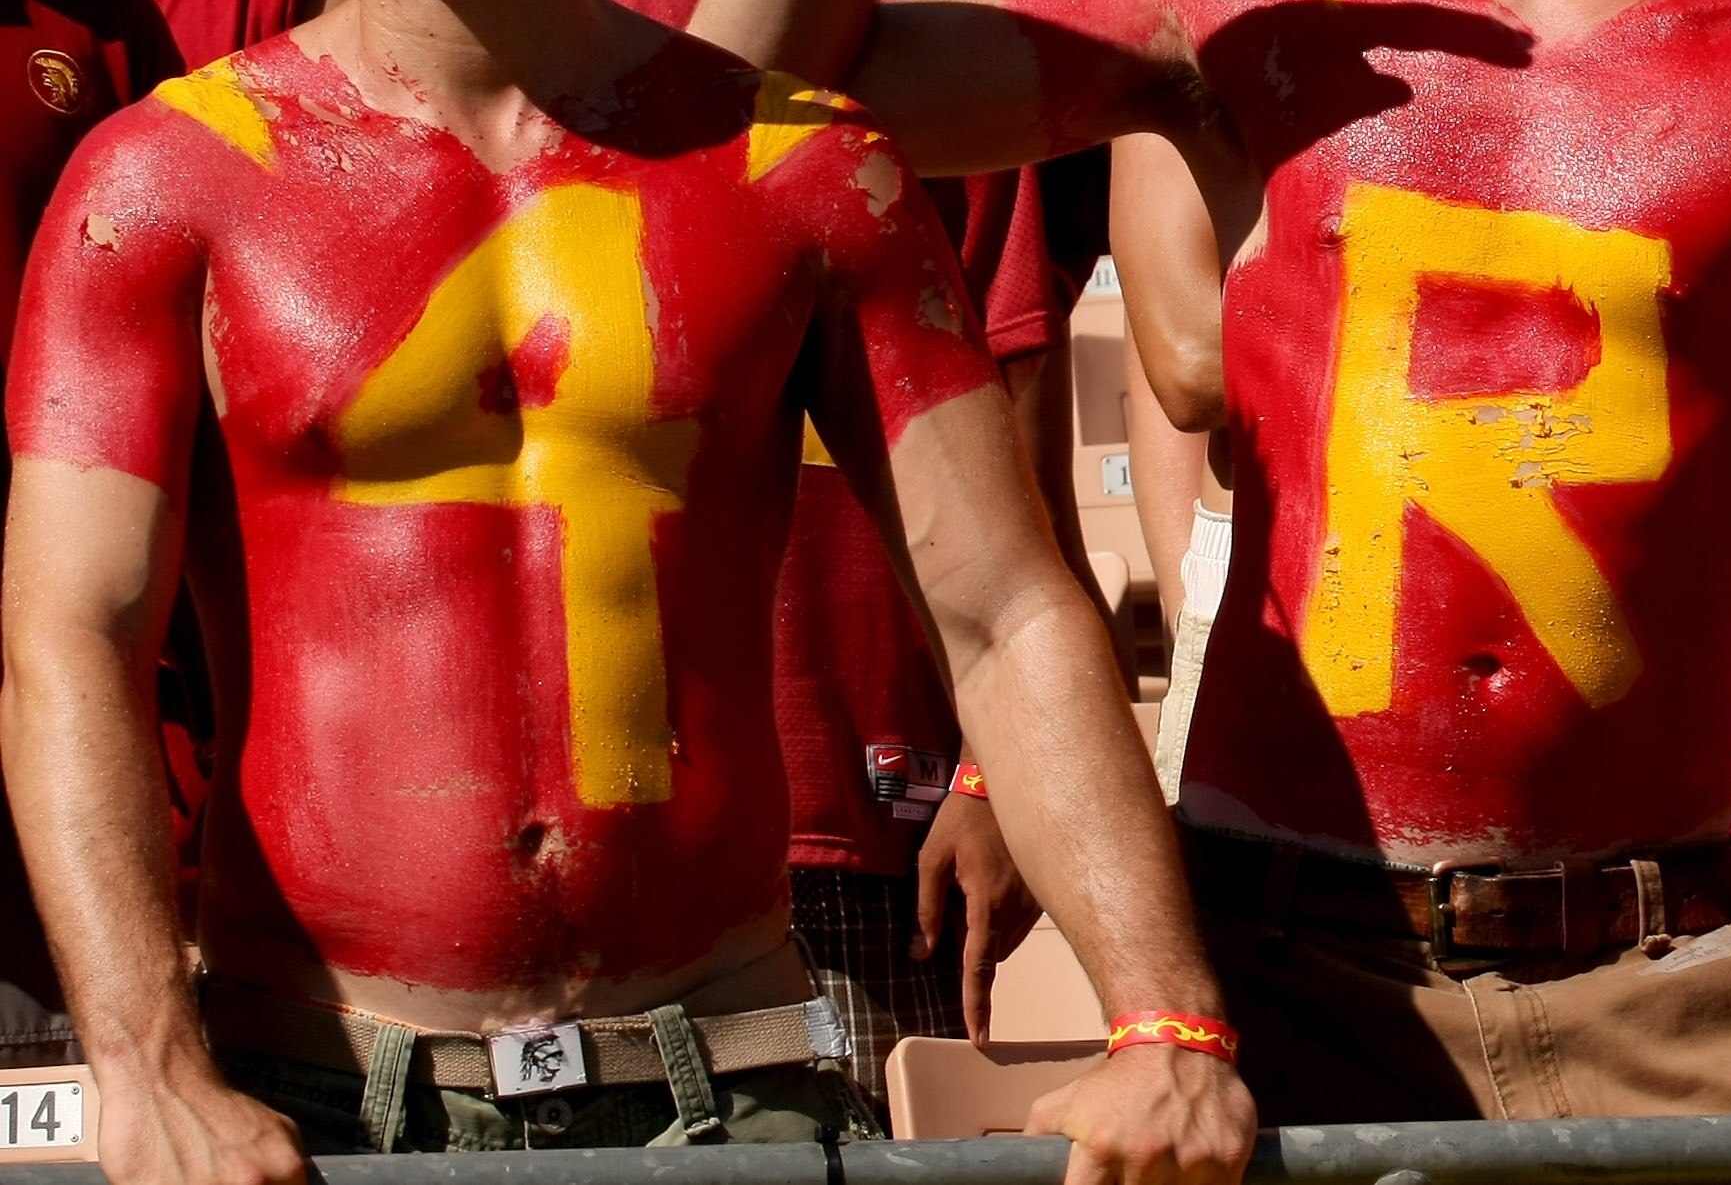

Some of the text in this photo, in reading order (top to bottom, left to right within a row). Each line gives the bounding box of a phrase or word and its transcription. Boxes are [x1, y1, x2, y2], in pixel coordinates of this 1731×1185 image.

[333, 181, 701, 809] 4
[1300, 179, 1672, 716] R
[2, 1090, 61, 1144] 14
